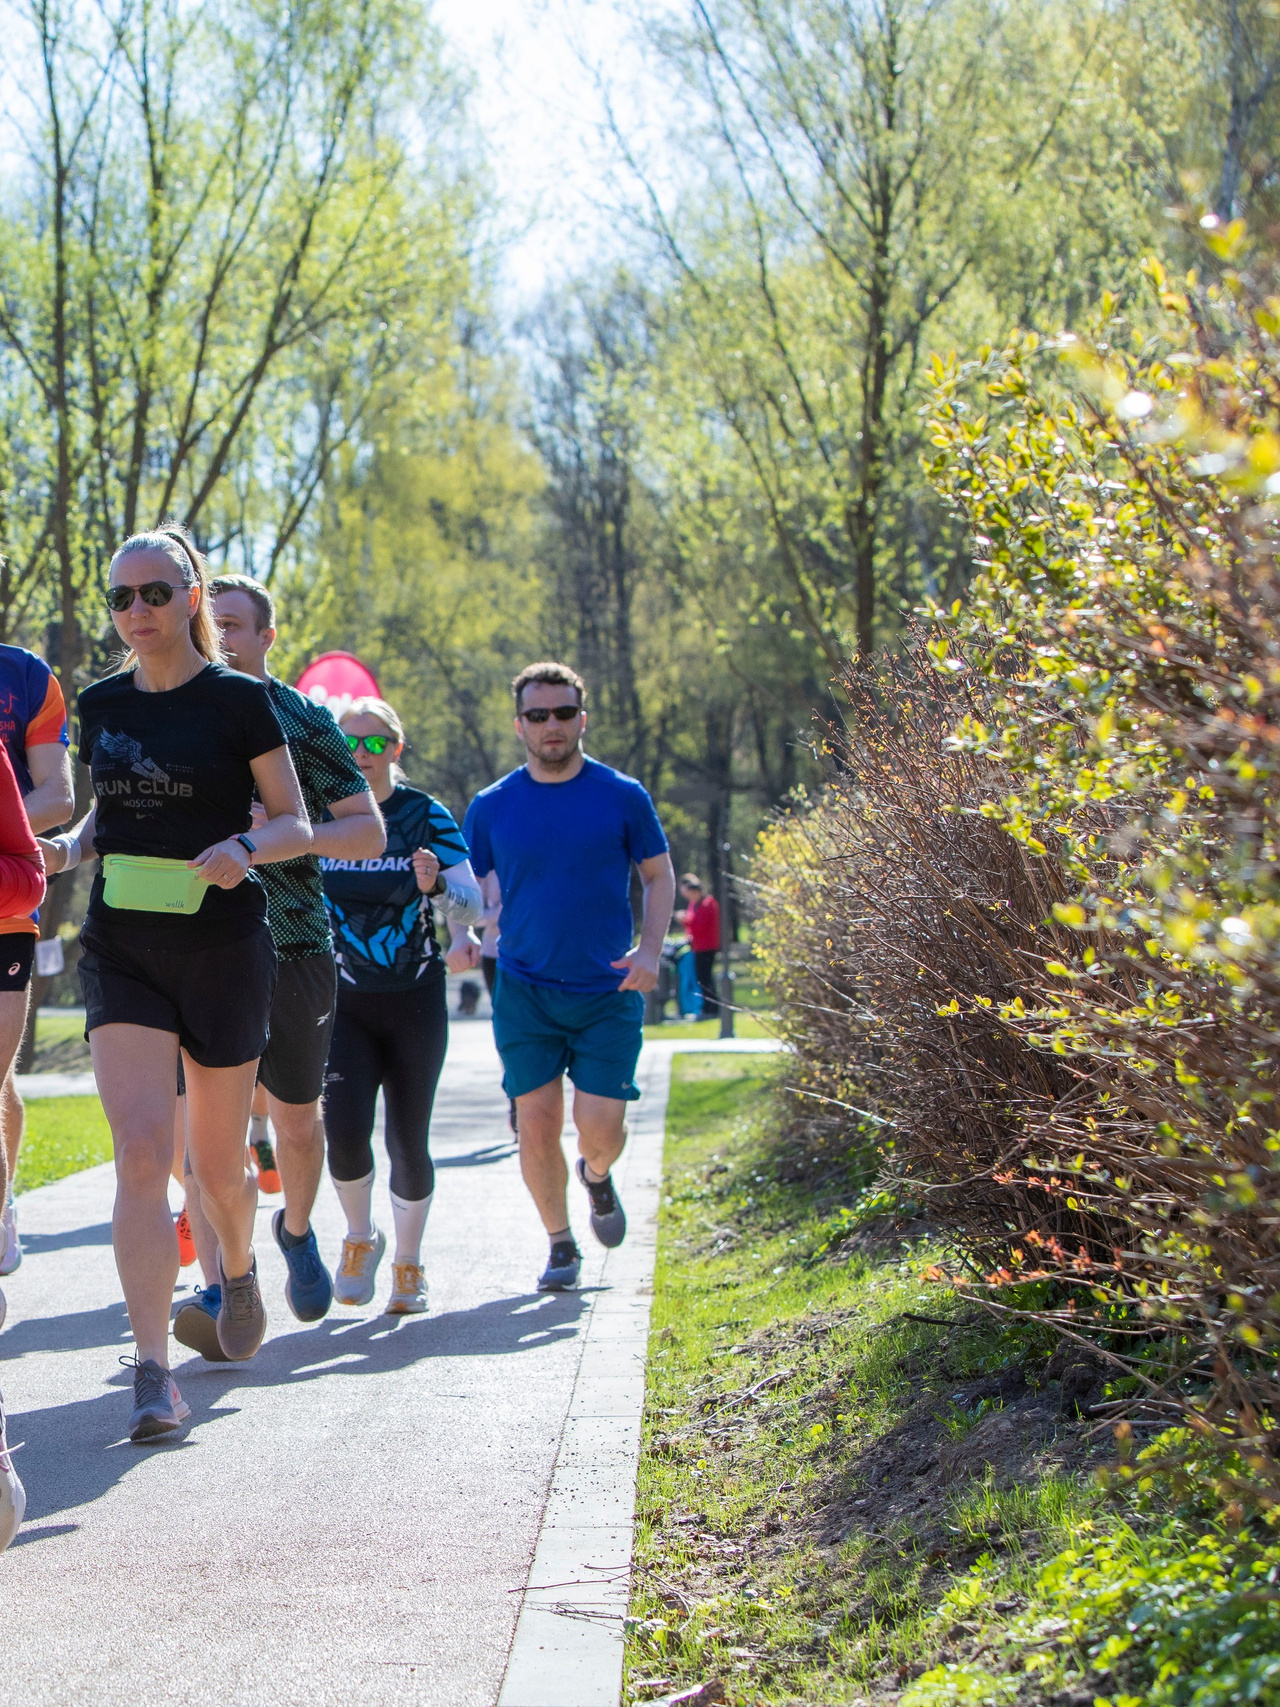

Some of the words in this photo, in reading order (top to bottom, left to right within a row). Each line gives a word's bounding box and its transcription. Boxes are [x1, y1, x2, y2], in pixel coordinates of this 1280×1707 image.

[95, 780, 131, 796] RUN
[138, 780, 193, 797] CLUB
[123, 799, 163, 808] MOSCOW
[321, 857, 412, 872] MALIDAK
